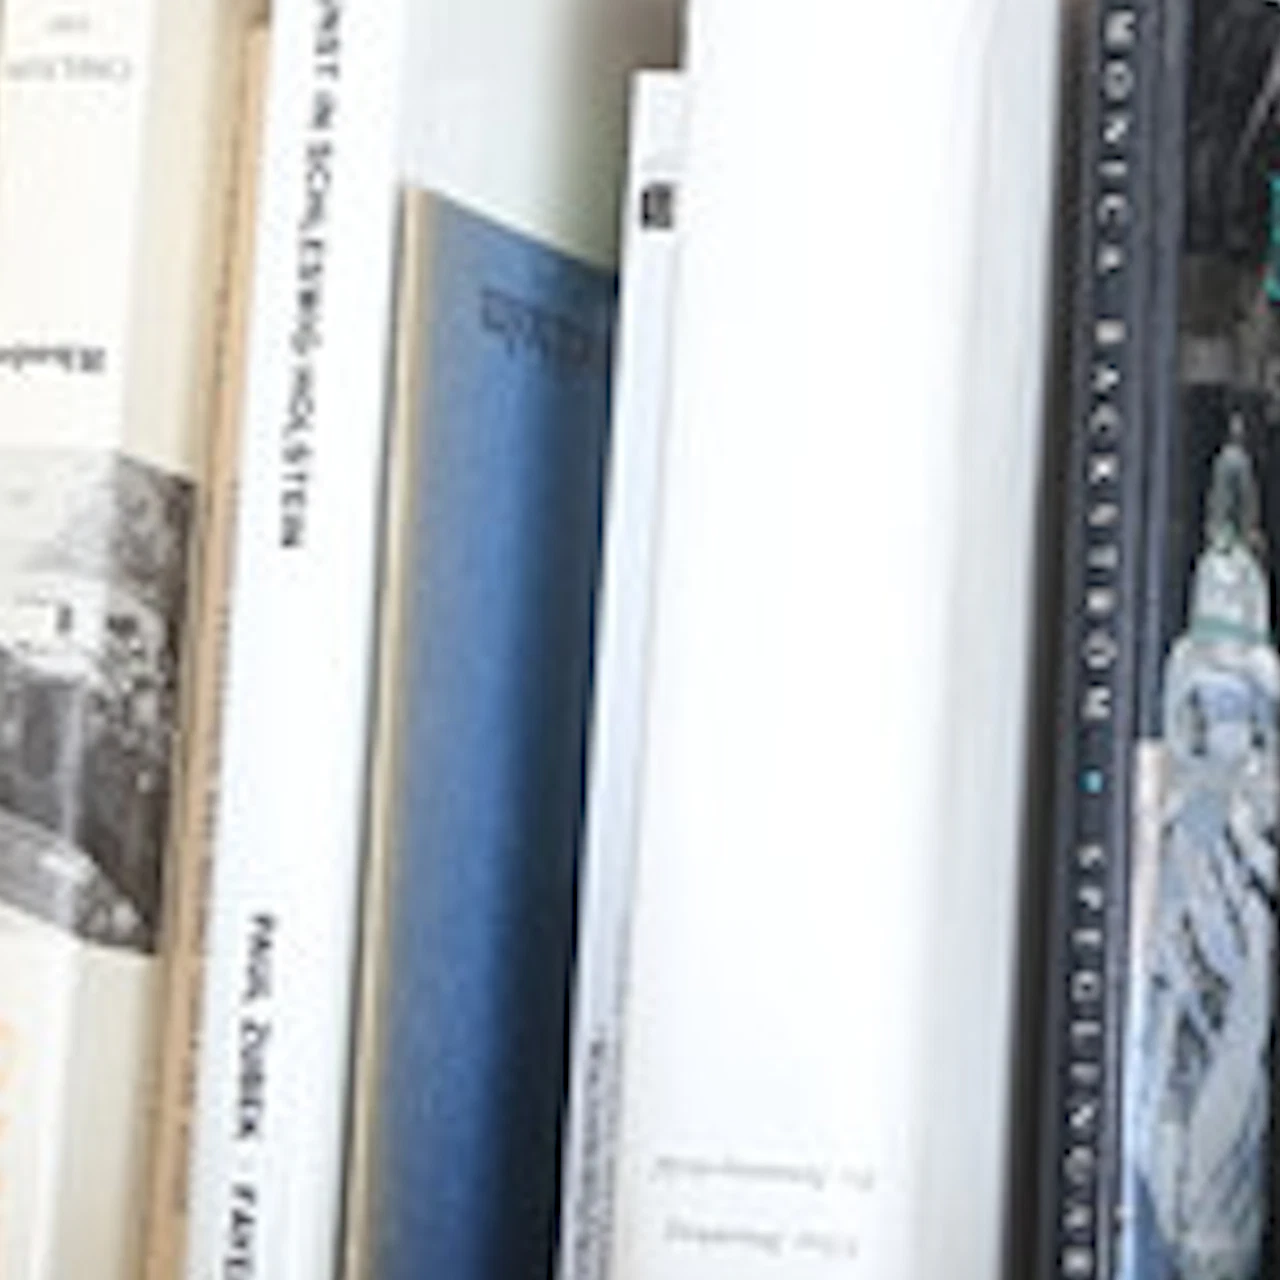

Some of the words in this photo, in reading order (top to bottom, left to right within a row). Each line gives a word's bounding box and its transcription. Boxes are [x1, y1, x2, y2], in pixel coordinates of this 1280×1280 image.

[309, 88, 336, 130] IN
[1097, 8, 1136, 273] MONICA
[240, 913, 275, 1004] PAUL
[236, 1021, 272, 1143] ZUBEK
[1060, 841, 1106, 1277] SPEGLINGAR
